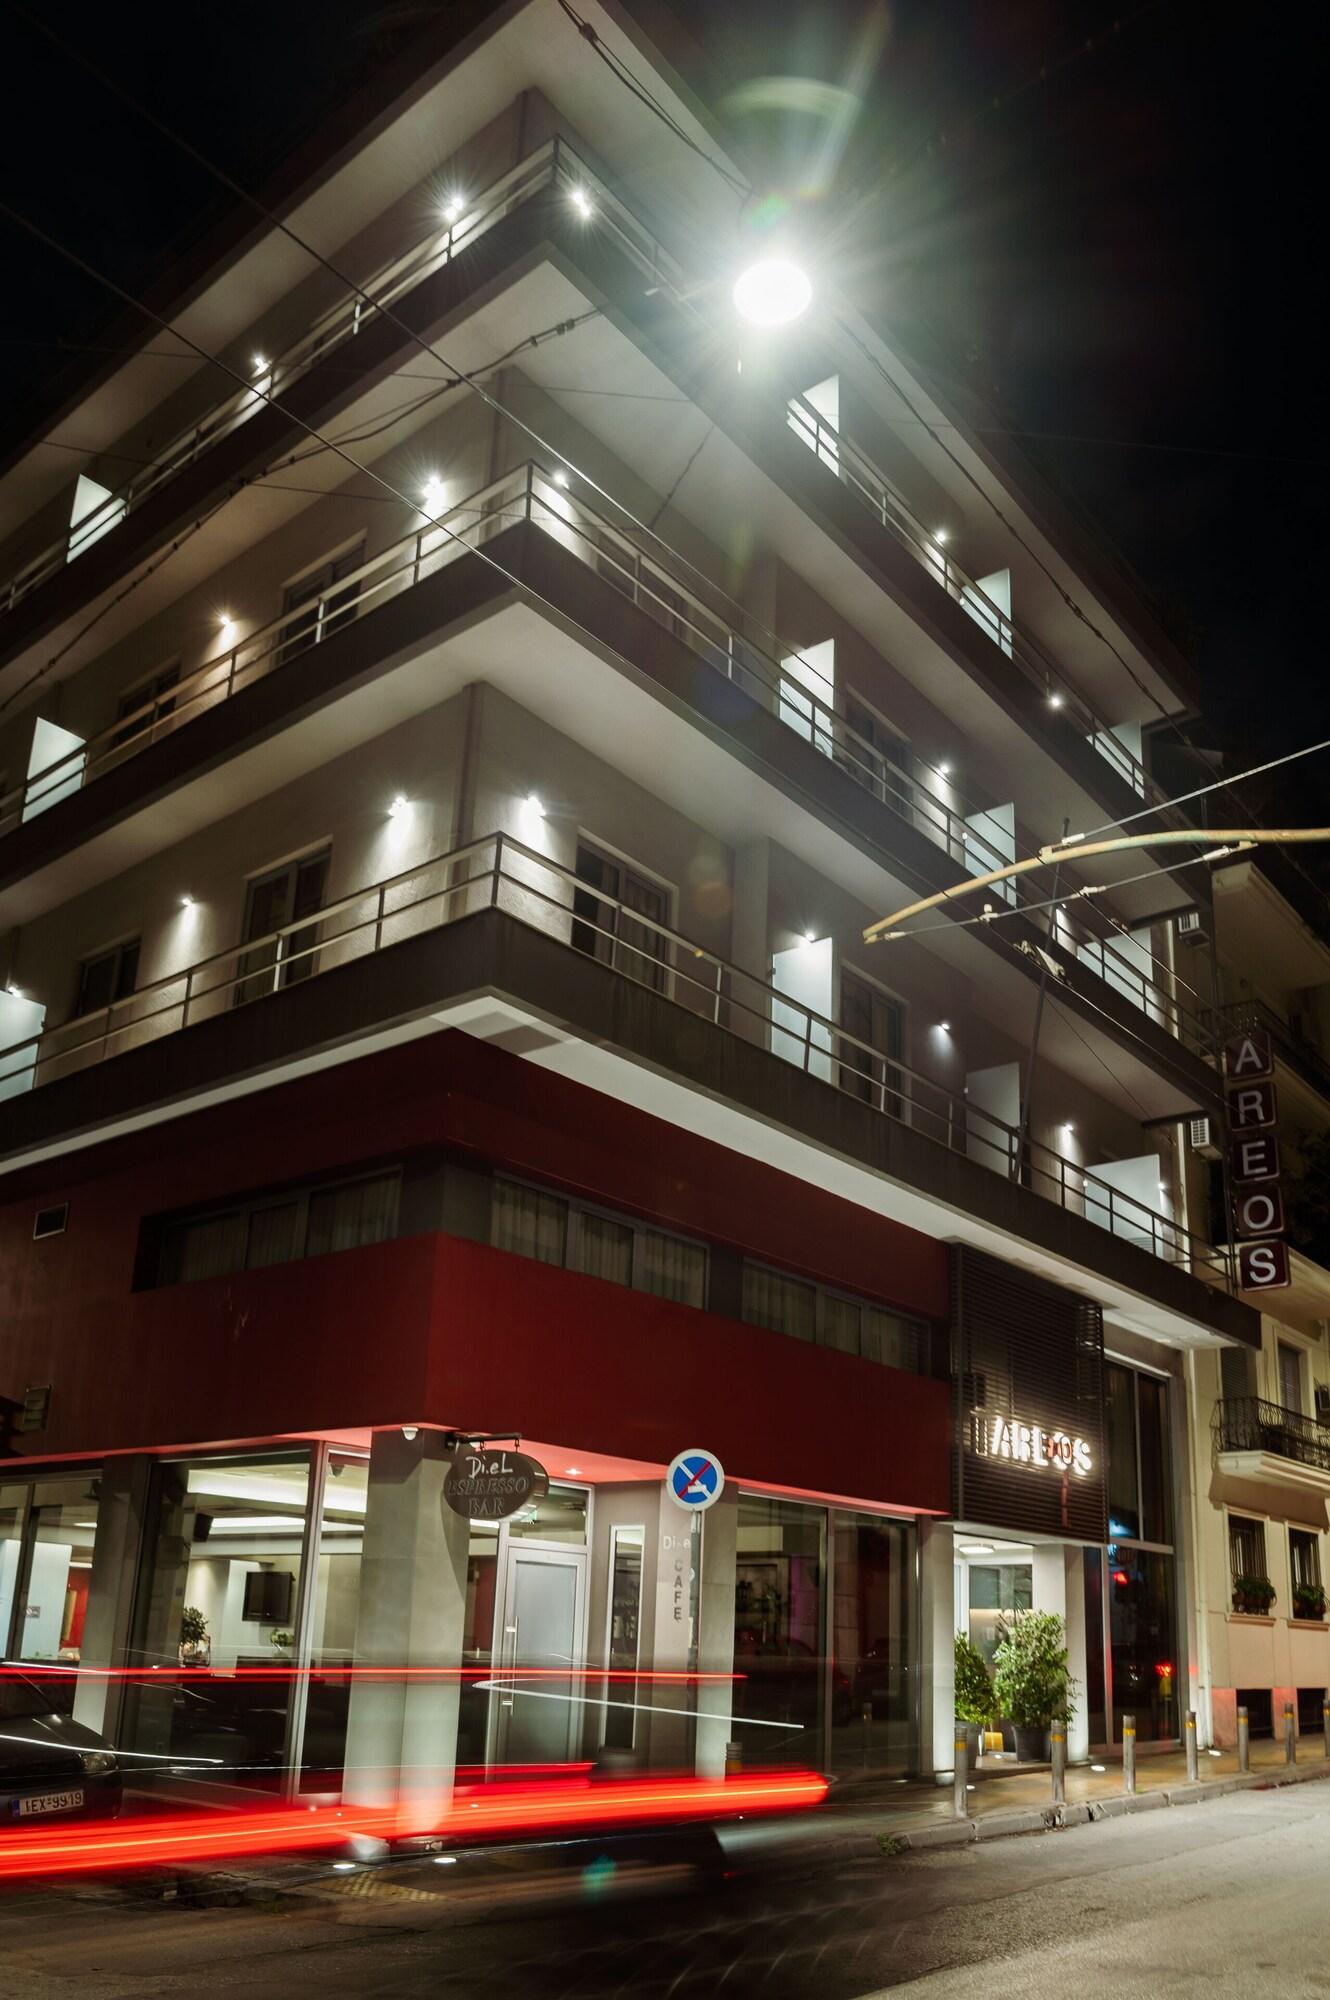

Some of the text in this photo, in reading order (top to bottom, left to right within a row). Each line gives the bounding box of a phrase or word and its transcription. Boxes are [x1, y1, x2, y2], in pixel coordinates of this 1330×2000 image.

[1234, 1040, 1276, 1284] AREOS
[991, 1416, 1093, 1476] AREOS
[448, 1477, 528, 1496] ESPRESSO
[468, 1497, 505, 1516] BAR
[673, 1560, 683, 1621] CAFE
